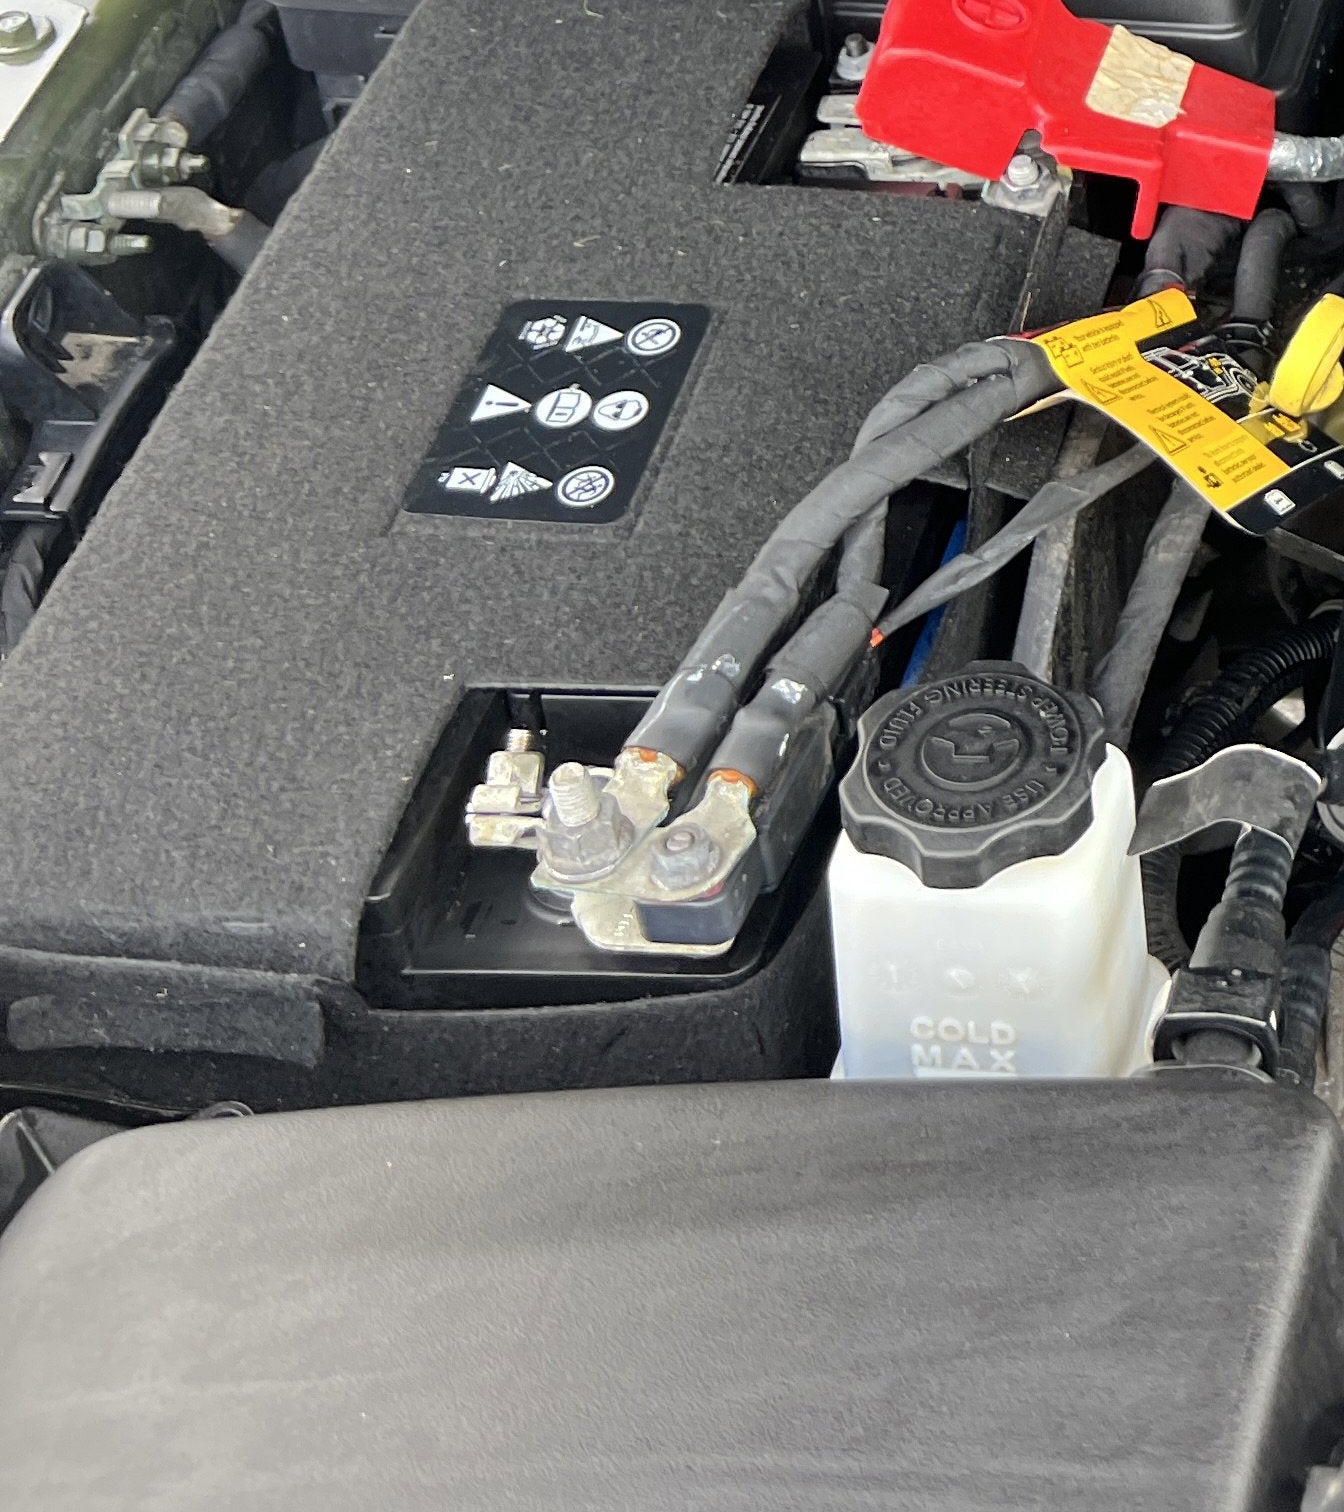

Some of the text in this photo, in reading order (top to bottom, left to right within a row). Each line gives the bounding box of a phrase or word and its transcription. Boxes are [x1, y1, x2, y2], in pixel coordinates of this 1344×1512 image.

[878, 676, 1073, 754] POWER STEERING FLUID
[882, 775, 1045, 822] USE APPROVED
[909, 1014, 1018, 1046] COLD
[910, 1042, 1018, 1073] MAX
